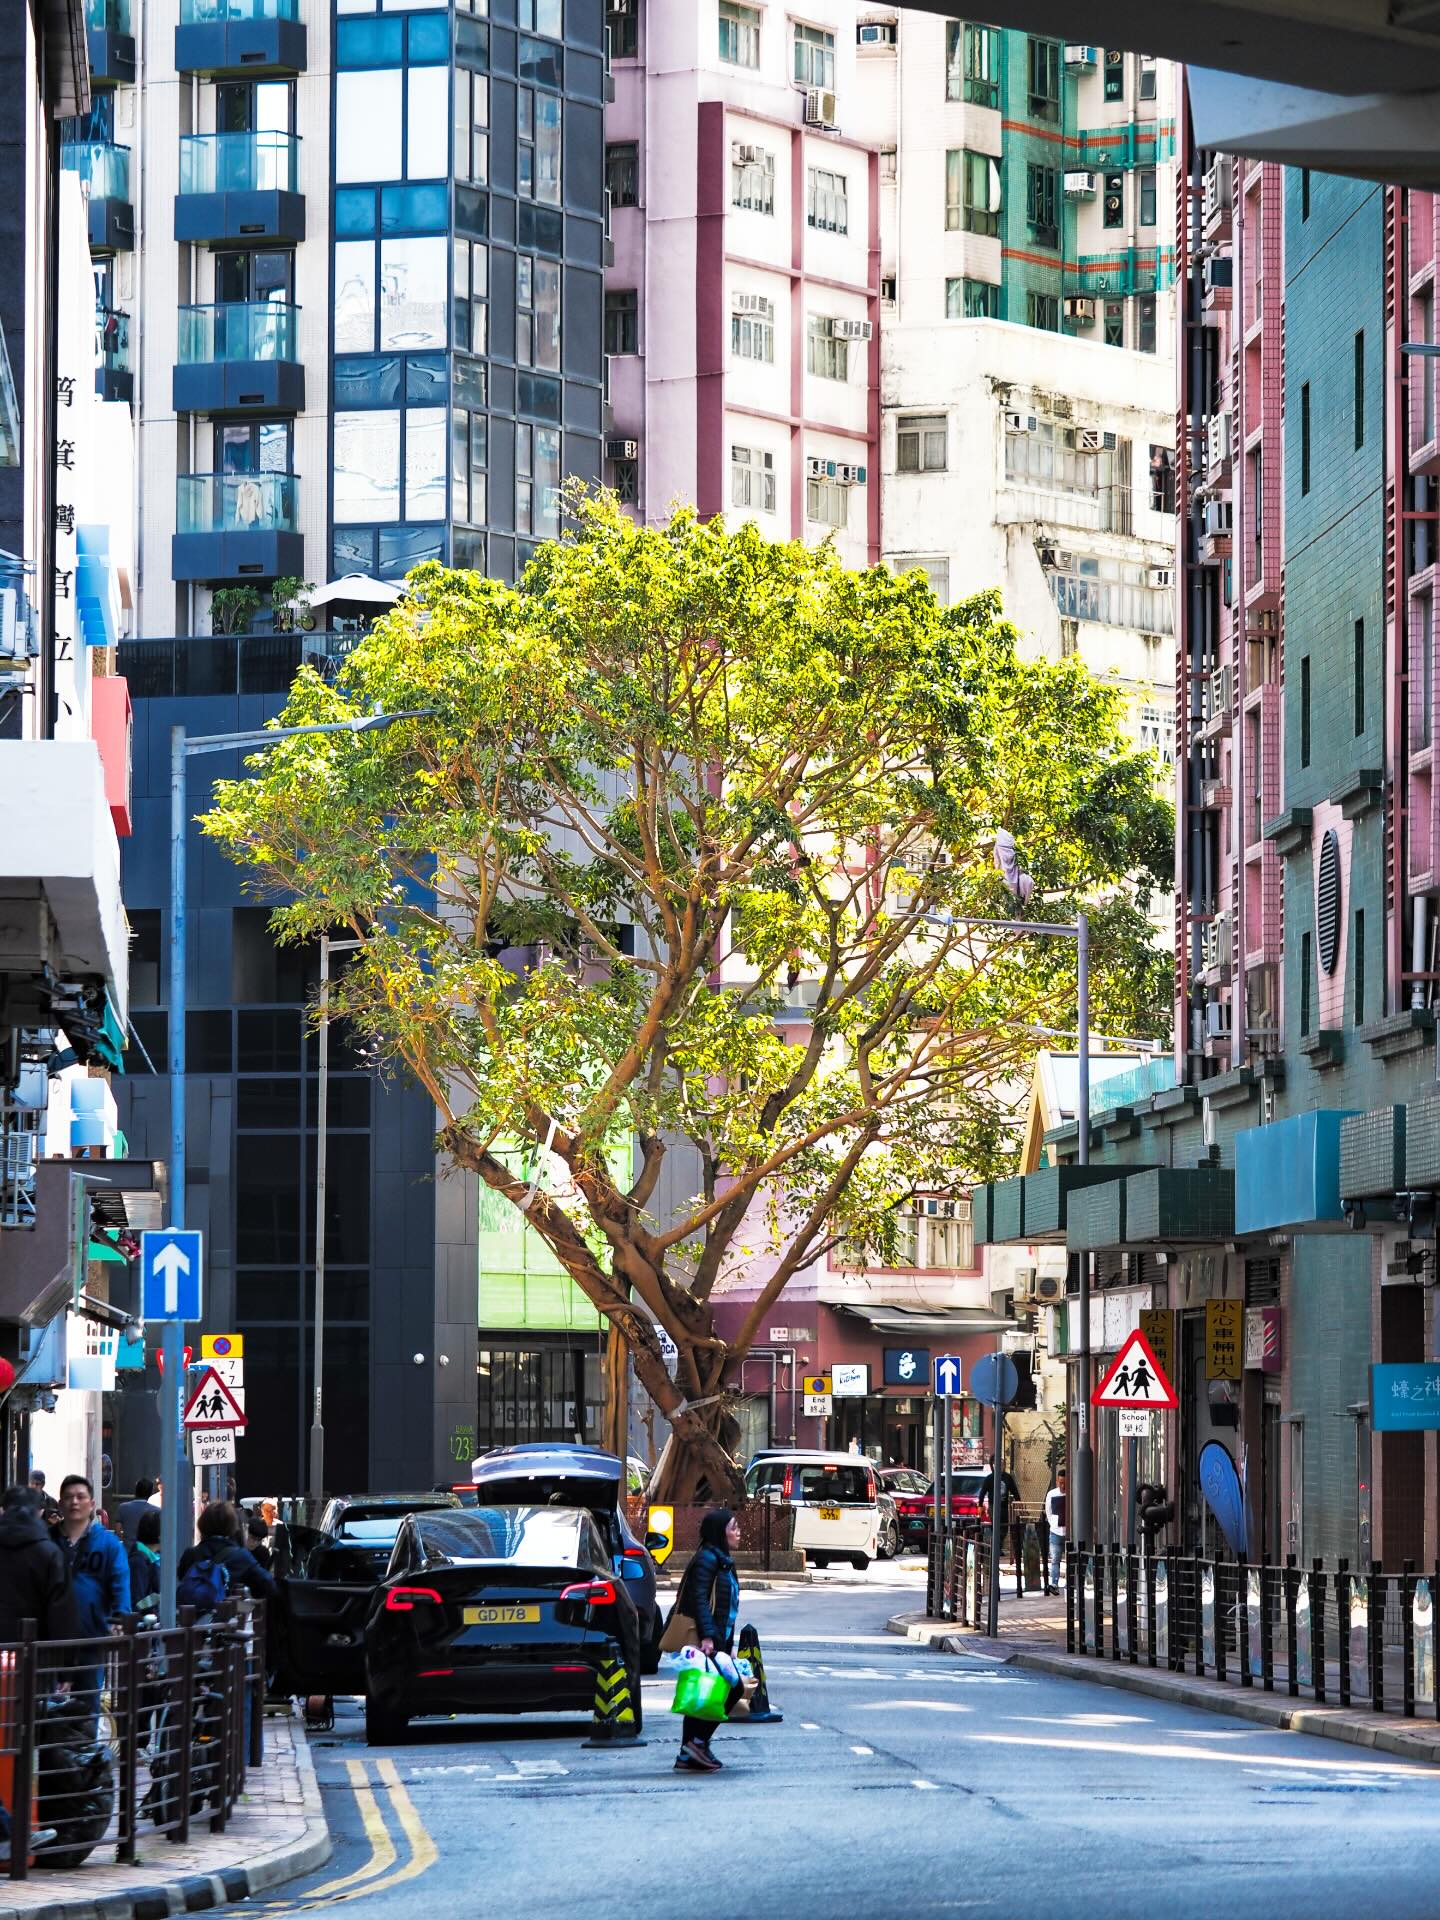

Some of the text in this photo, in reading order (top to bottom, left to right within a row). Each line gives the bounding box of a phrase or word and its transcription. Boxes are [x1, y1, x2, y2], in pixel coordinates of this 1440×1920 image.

[1212, 1301, 1236, 1378] 小心車輛出入
[228, 1360, 235, 1370] 7
[228, 1375, 235, 1385] 7
[1121, 1413, 1147, 1421] School
[1124, 1423, 1144, 1433] 學校
[195, 1433, 231, 1444] School
[200, 1446, 228, 1460] 學校
[477, 1607, 526, 1622] GD 178
